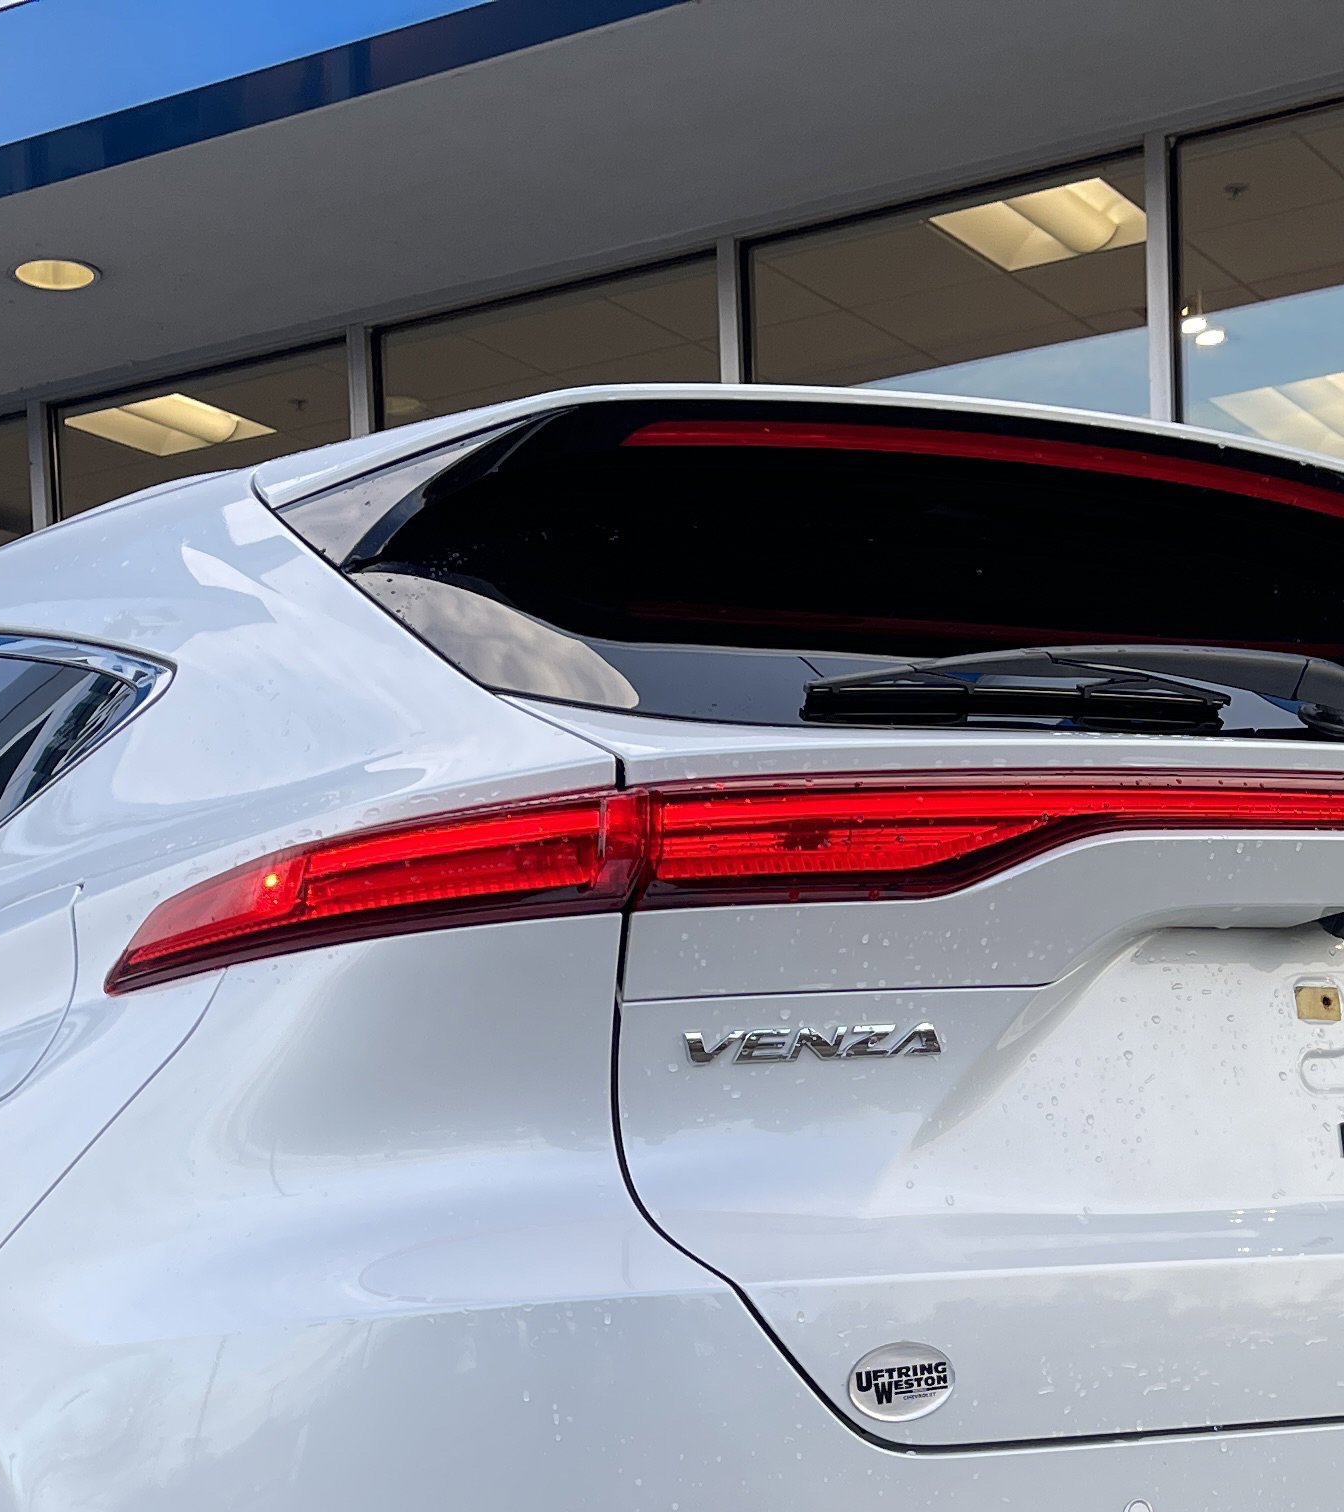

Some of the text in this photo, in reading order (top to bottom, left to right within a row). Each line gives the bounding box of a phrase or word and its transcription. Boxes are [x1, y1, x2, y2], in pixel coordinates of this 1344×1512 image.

[683, 1022, 942, 1066] VENZA
[856, 1361, 947, 1392] UFTRING
[873, 1374, 948, 1405] WESTON
